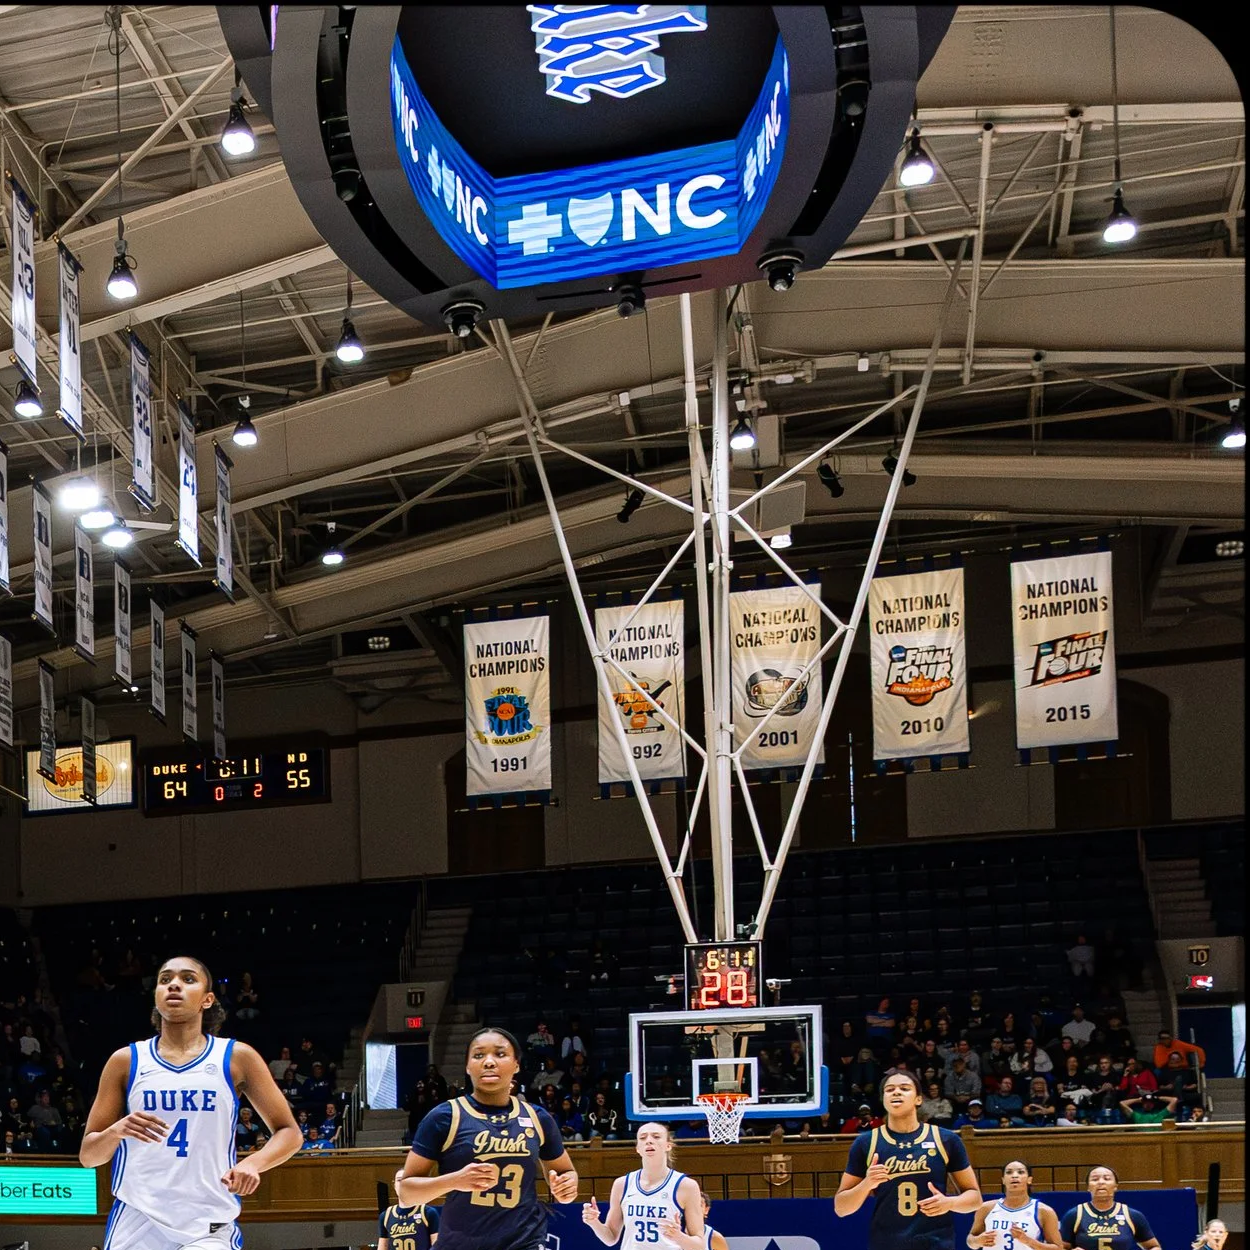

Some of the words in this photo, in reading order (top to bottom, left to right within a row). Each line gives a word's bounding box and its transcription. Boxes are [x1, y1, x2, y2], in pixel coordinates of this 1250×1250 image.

[456, 175, 489, 245] NC
[622, 174, 725, 241] NC
[1027, 577, 1098, 599] NATIONAL
[882, 593, 951, 615] NATIONAL
[1018, 596, 1108, 620] CHAMPIONS
[743, 607, 808, 629] NATIONAL
[876, 612, 960, 635] CHAMPIONS
[735, 625, 816, 648] CHAMPIONS
[476, 638, 538, 659] NATIONAL
[602, 642, 680, 663] HAMPIONS
[469, 656, 545, 679] CHAMPIONS
[1046, 705, 1091, 723] 2015
[901, 717, 944, 735] 2010
[758, 730, 798, 748] 2001
[633, 743, 662, 760] 992
[153, 764, 187, 776] DUKE
[490, 756, 528, 774] 1991
[164, 781, 187, 799] 64
[215, 786, 224, 801] 0
[254, 783, 263, 798] 2
[287, 769, 310, 788] 55
[706, 950, 754, 970] 6:11
[701, 970, 748, 1006] 28
[142, 1090, 217, 1112] DUKE
[166, 1118, 189, 1158] 4
[472, 1128, 530, 1156] Irish
[884, 1154, 929, 1177] Irish
[32, 1182, 72, 1199] Eats
[470, 1164, 524, 1209] 23
[897, 1181, 918, 1217] 8
[627, 1204, 667, 1219] DUKE
[390, 1222, 416, 1235] Irish
[634, 1221, 658, 1243] 35
[1087, 1223, 1118, 1235] Irish
